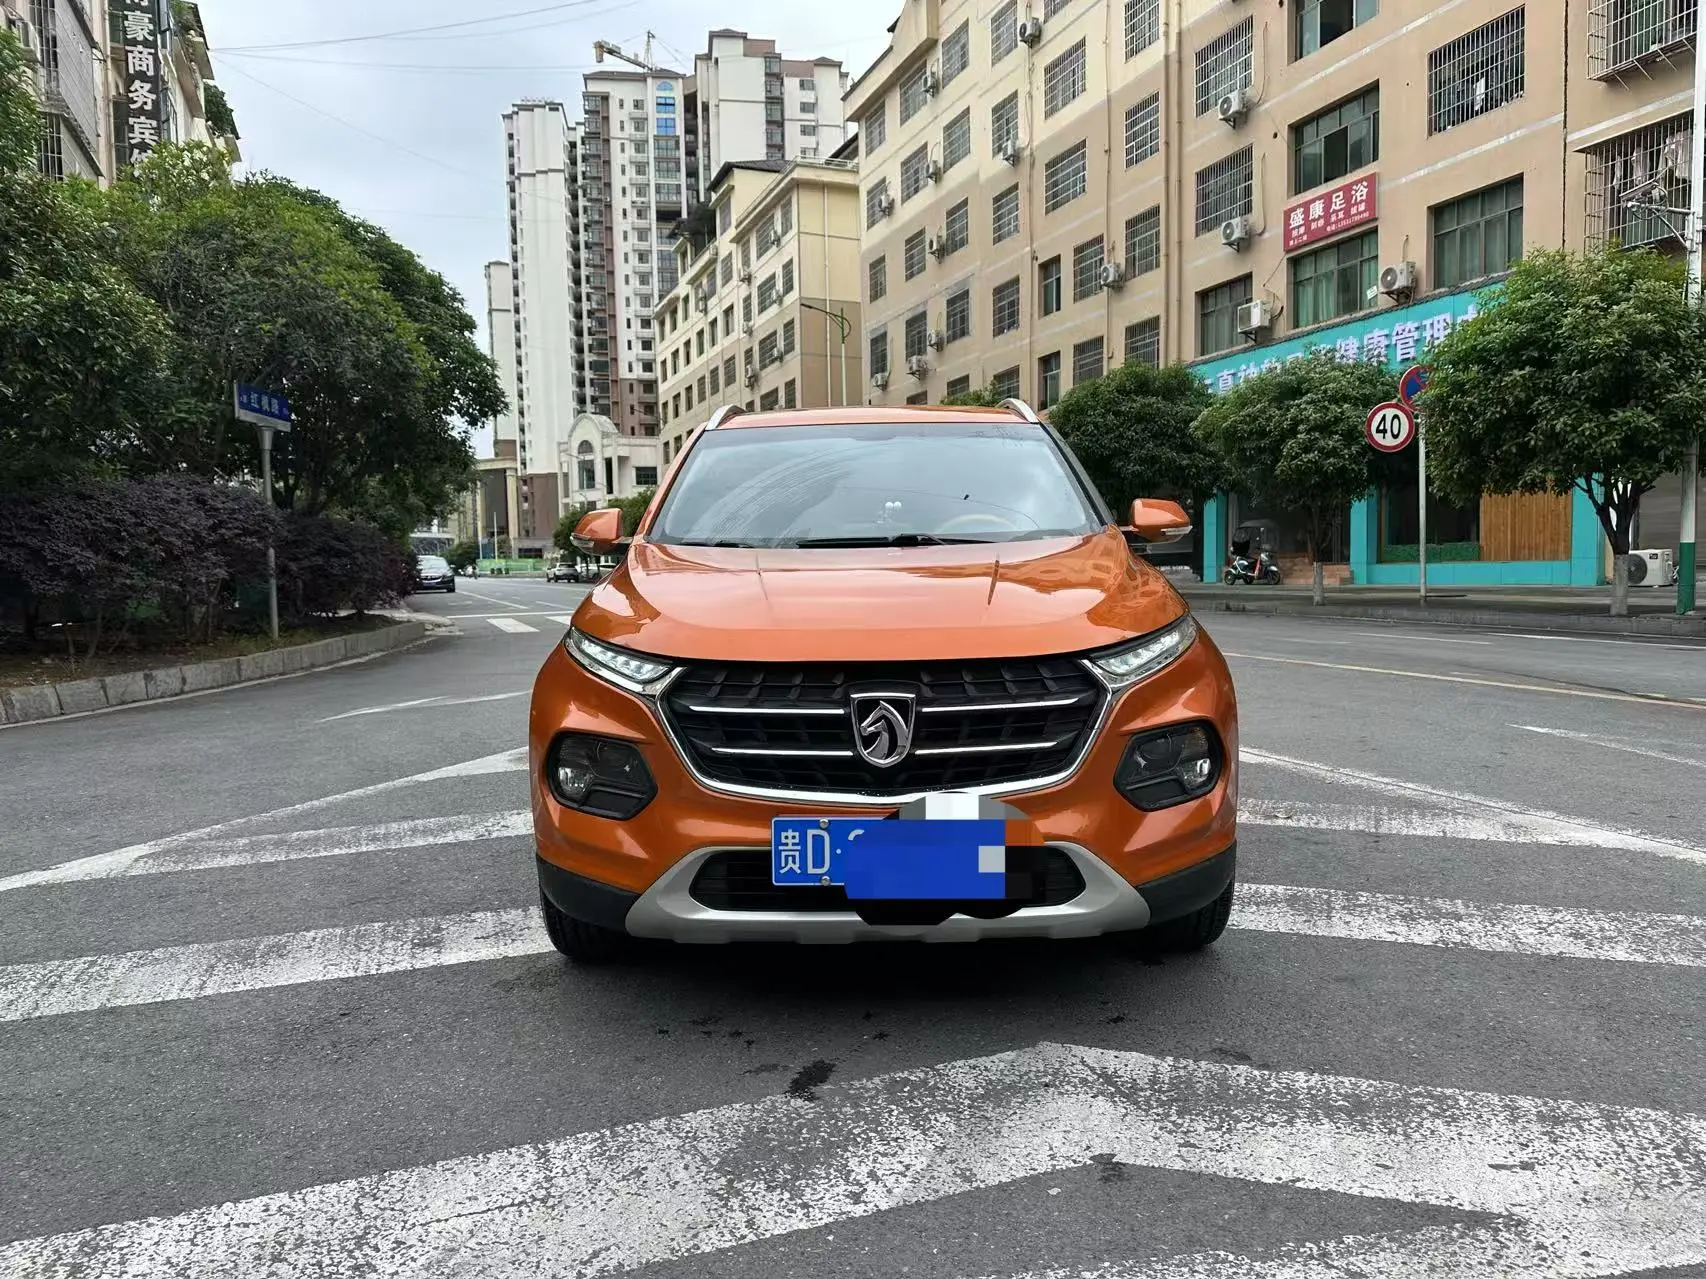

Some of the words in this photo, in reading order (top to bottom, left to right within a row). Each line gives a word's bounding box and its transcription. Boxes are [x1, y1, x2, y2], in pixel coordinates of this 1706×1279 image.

[1289, 181, 1369, 228] 盛康足浴
[1376, 413, 1402, 440] 40
